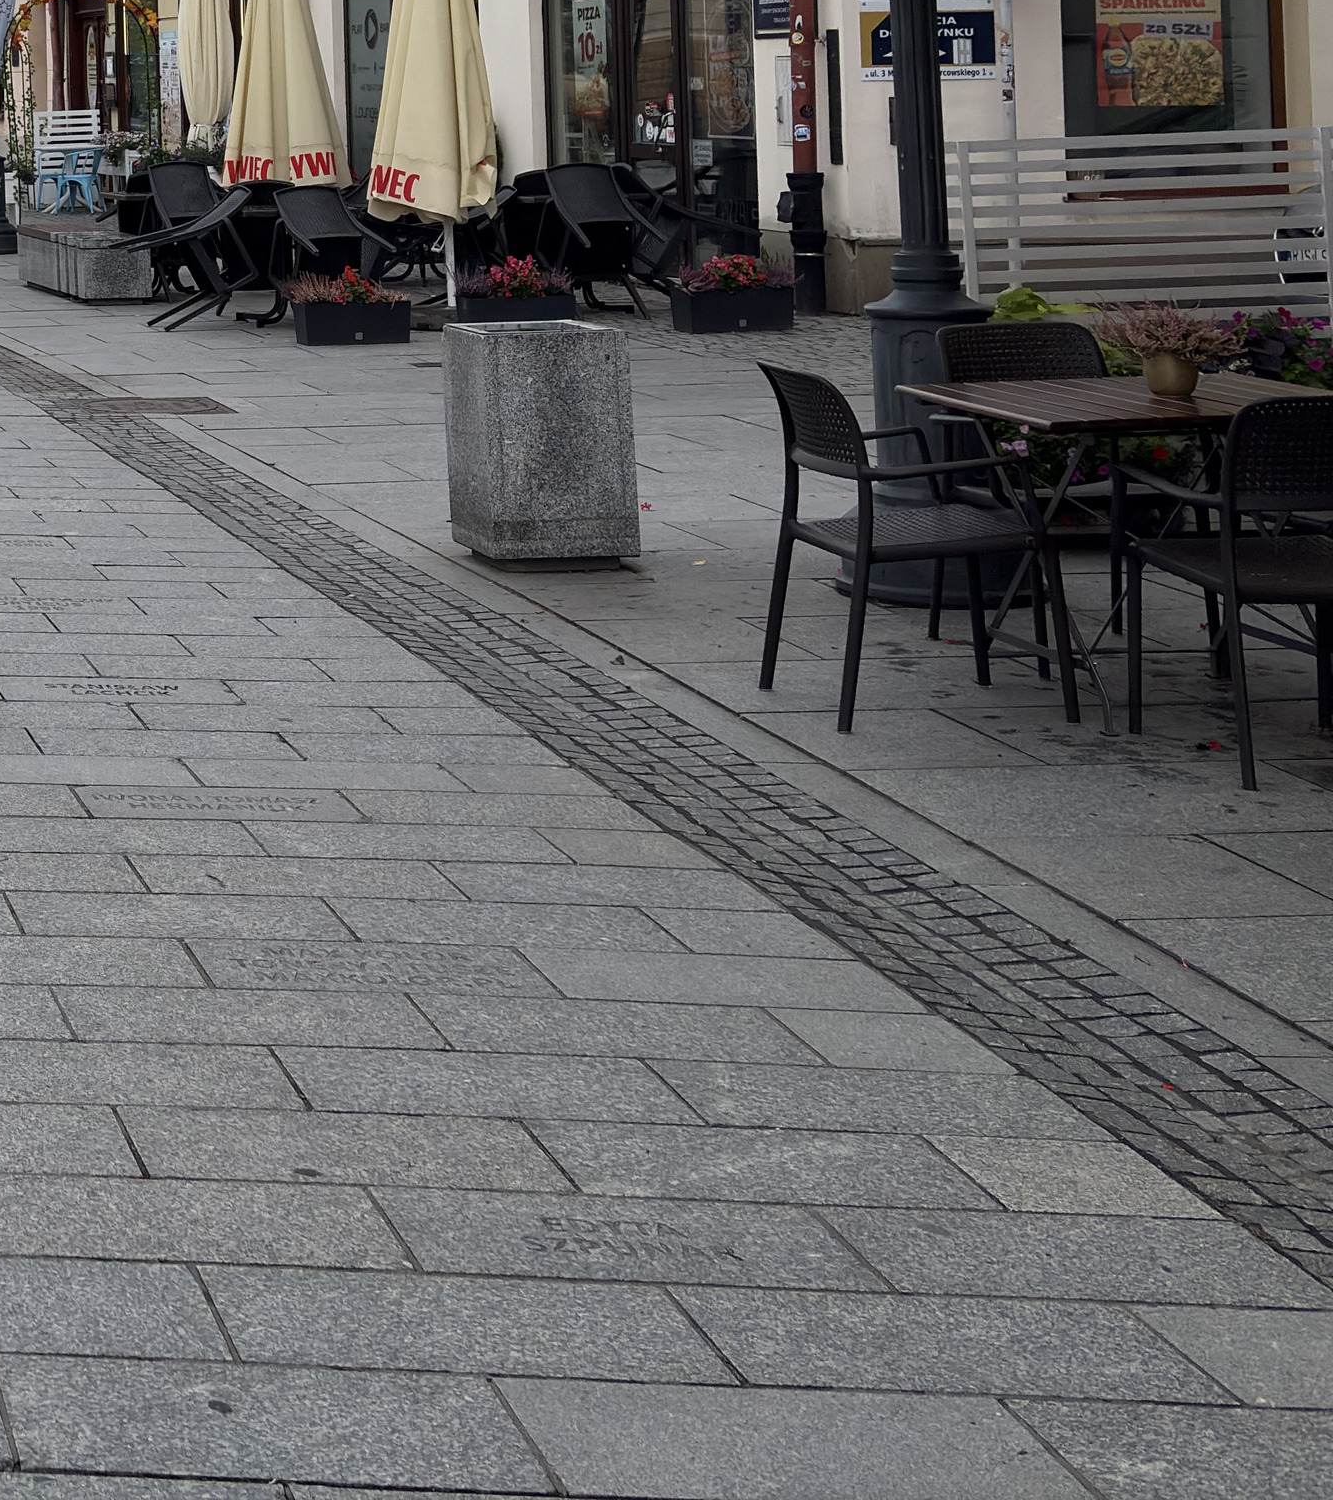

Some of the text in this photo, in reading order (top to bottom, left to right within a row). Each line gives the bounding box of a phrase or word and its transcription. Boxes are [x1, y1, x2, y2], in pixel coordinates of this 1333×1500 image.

[577, 6, 601, 21] PIZZA
[586, 22, 592, 31] ZA
[1146, 25, 1166, 34] za
[938, 28, 974, 37] YNKU
[577, 32, 602, 63] 10 zł
[91, 794, 188, 802] IWONA
[540, 1217, 690, 1240] EDYTA
